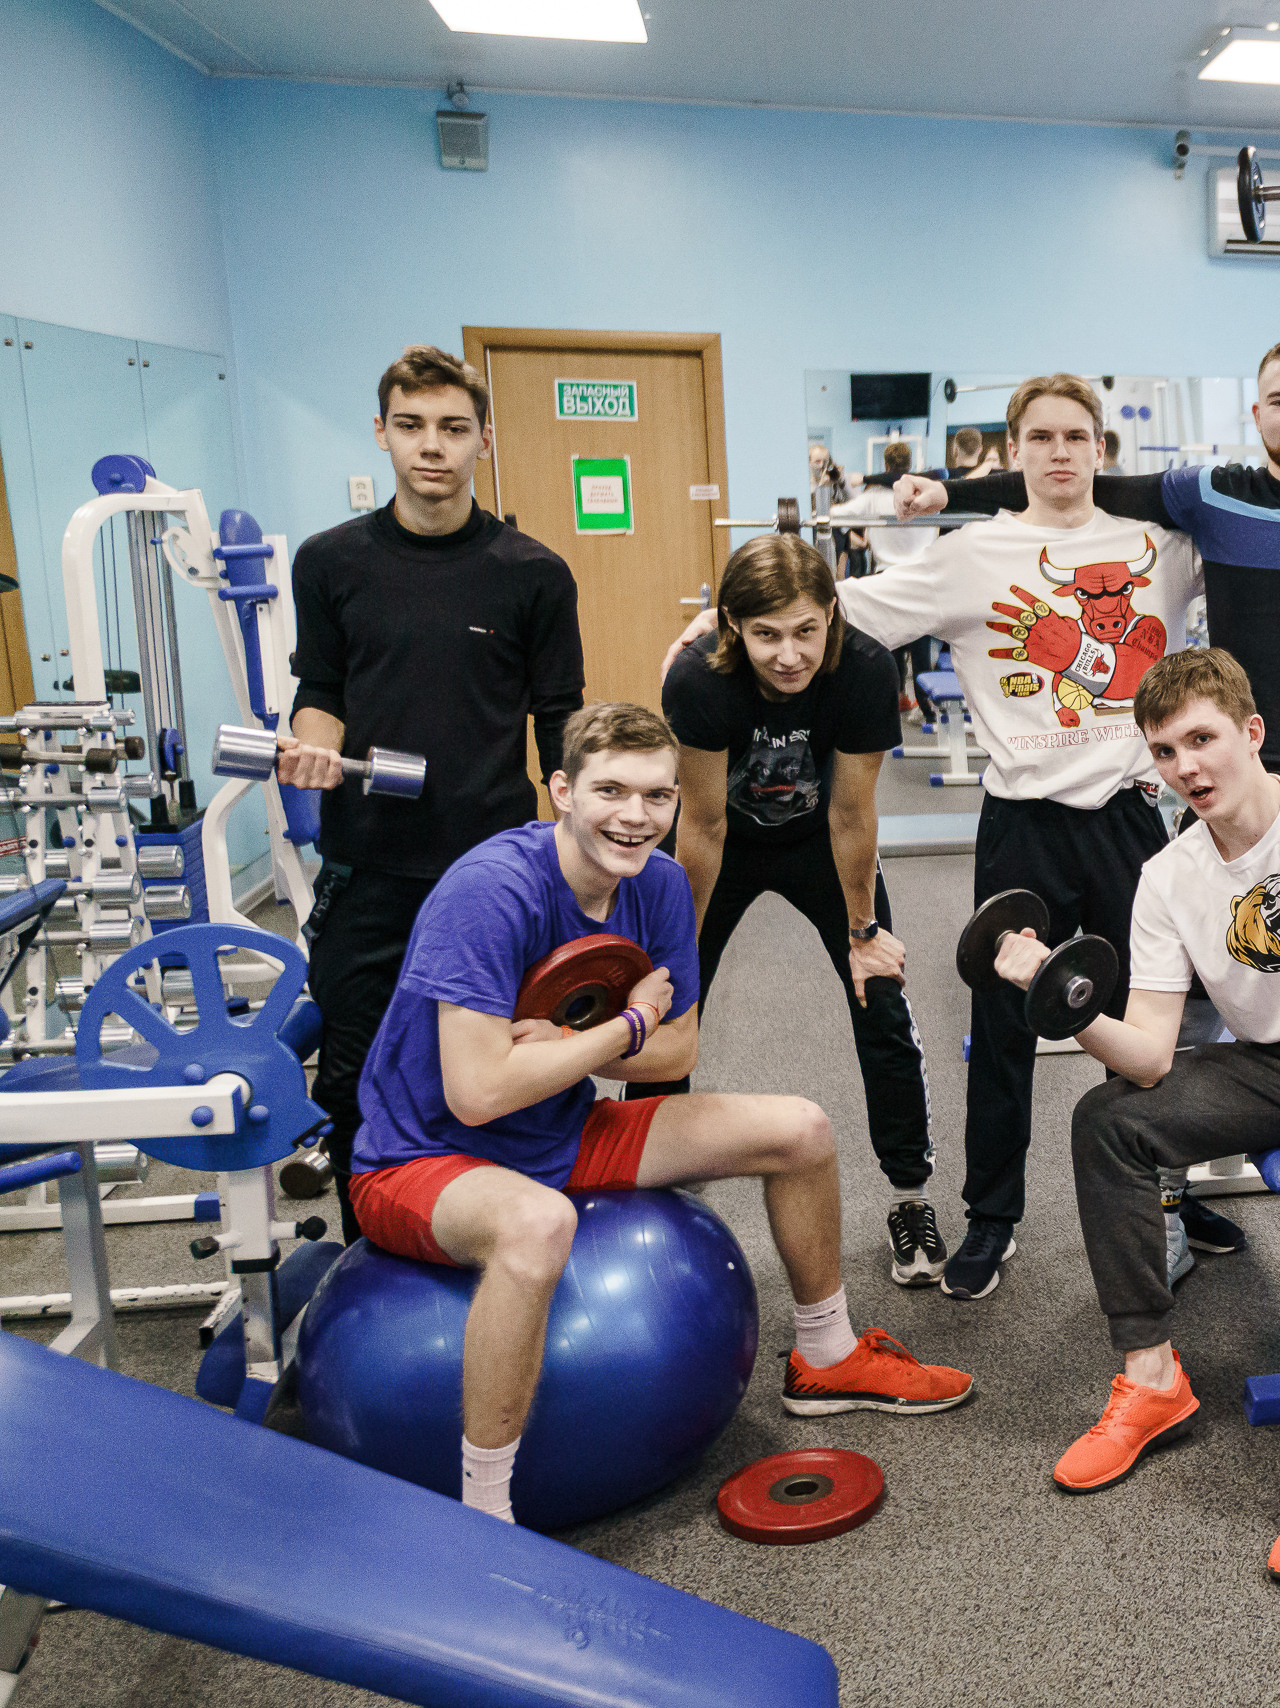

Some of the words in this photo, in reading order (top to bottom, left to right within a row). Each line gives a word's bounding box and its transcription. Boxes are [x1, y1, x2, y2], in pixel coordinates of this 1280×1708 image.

[562, 384, 629, 397] ЗАПАСНЫЙ
[563, 395, 631, 417] ВЫХОД
[1074, 643, 1092, 673] CHICAGO
[1082, 650, 1096, 671] BULLS
[1009, 675, 1032, 686] NBA
[1009, 682, 1040, 693] Finals
